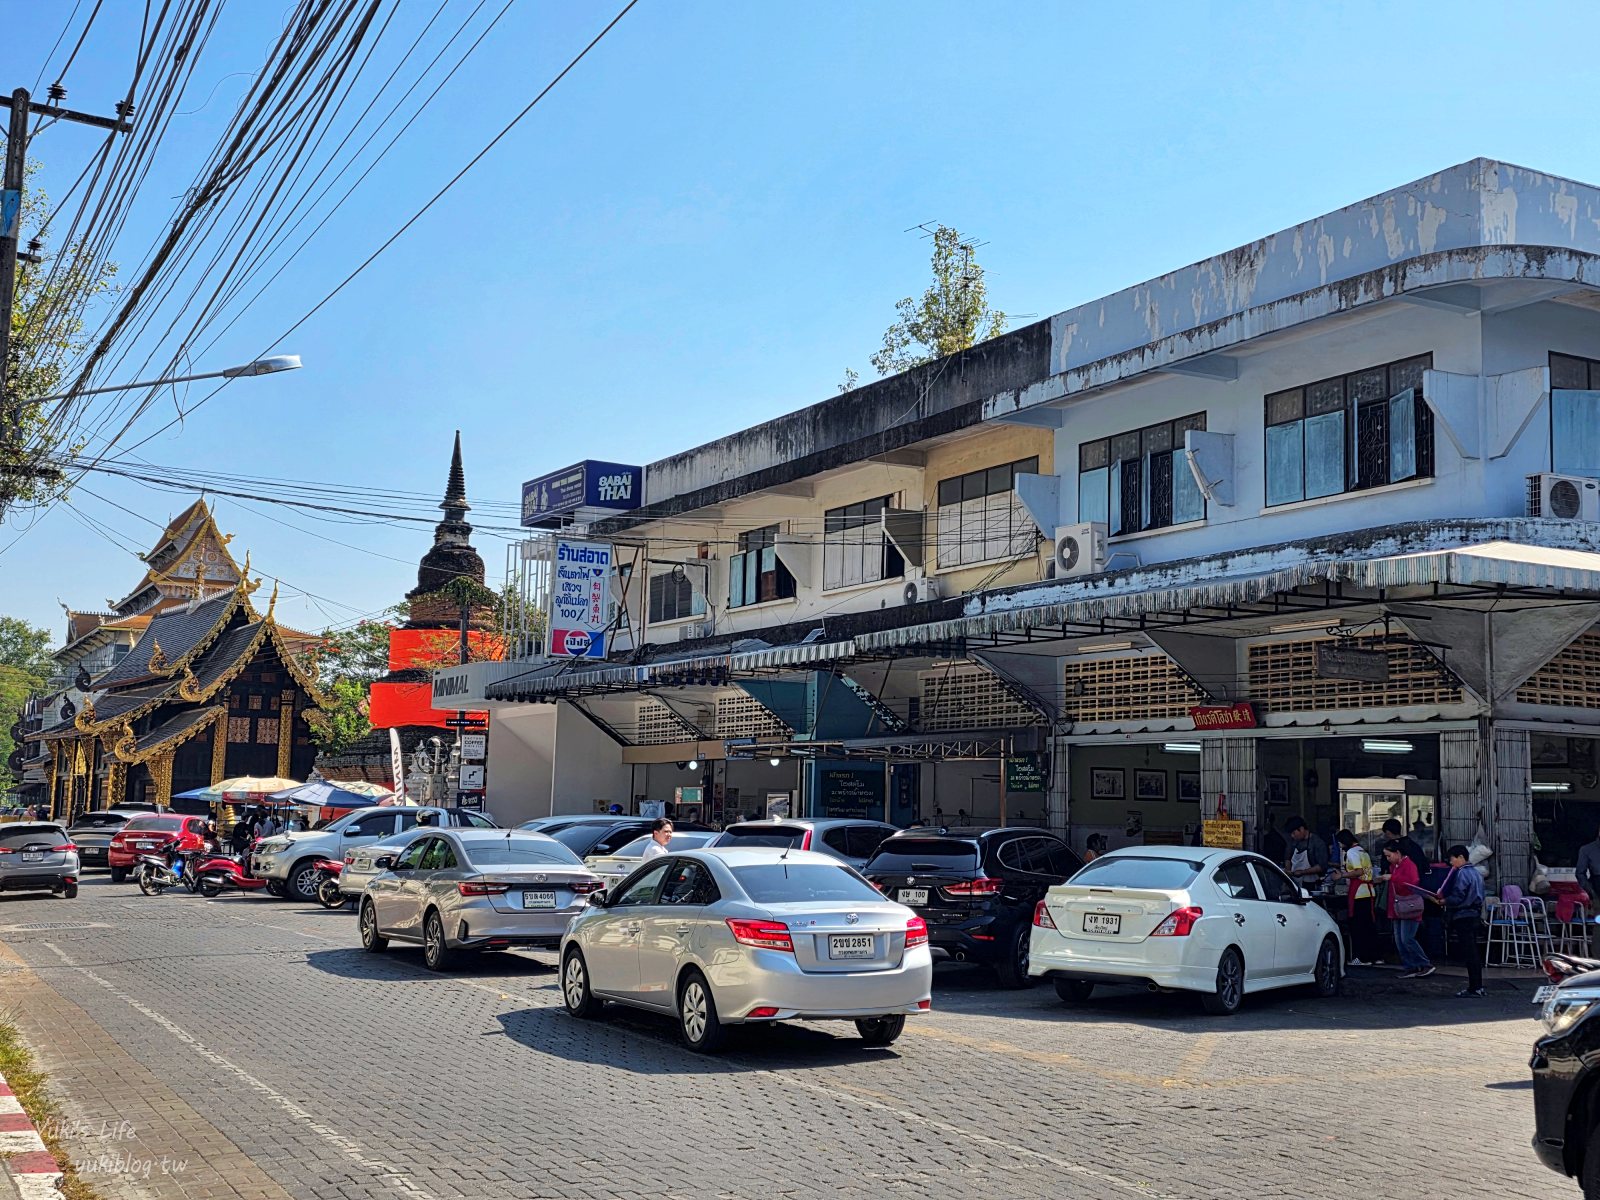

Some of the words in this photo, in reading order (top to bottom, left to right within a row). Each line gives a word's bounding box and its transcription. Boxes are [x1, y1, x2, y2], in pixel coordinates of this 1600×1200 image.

[598, 475, 632, 487] SABAI
[599, 485, 632, 500] THAI
[558, 543, 609, 565] ร้านสอาด
[560, 609, 585, 621] 100%
[433, 674, 469, 697] MINIMAL
[1102, 917, 1118, 925] 1931
[852, 938, 871, 948] 2851
